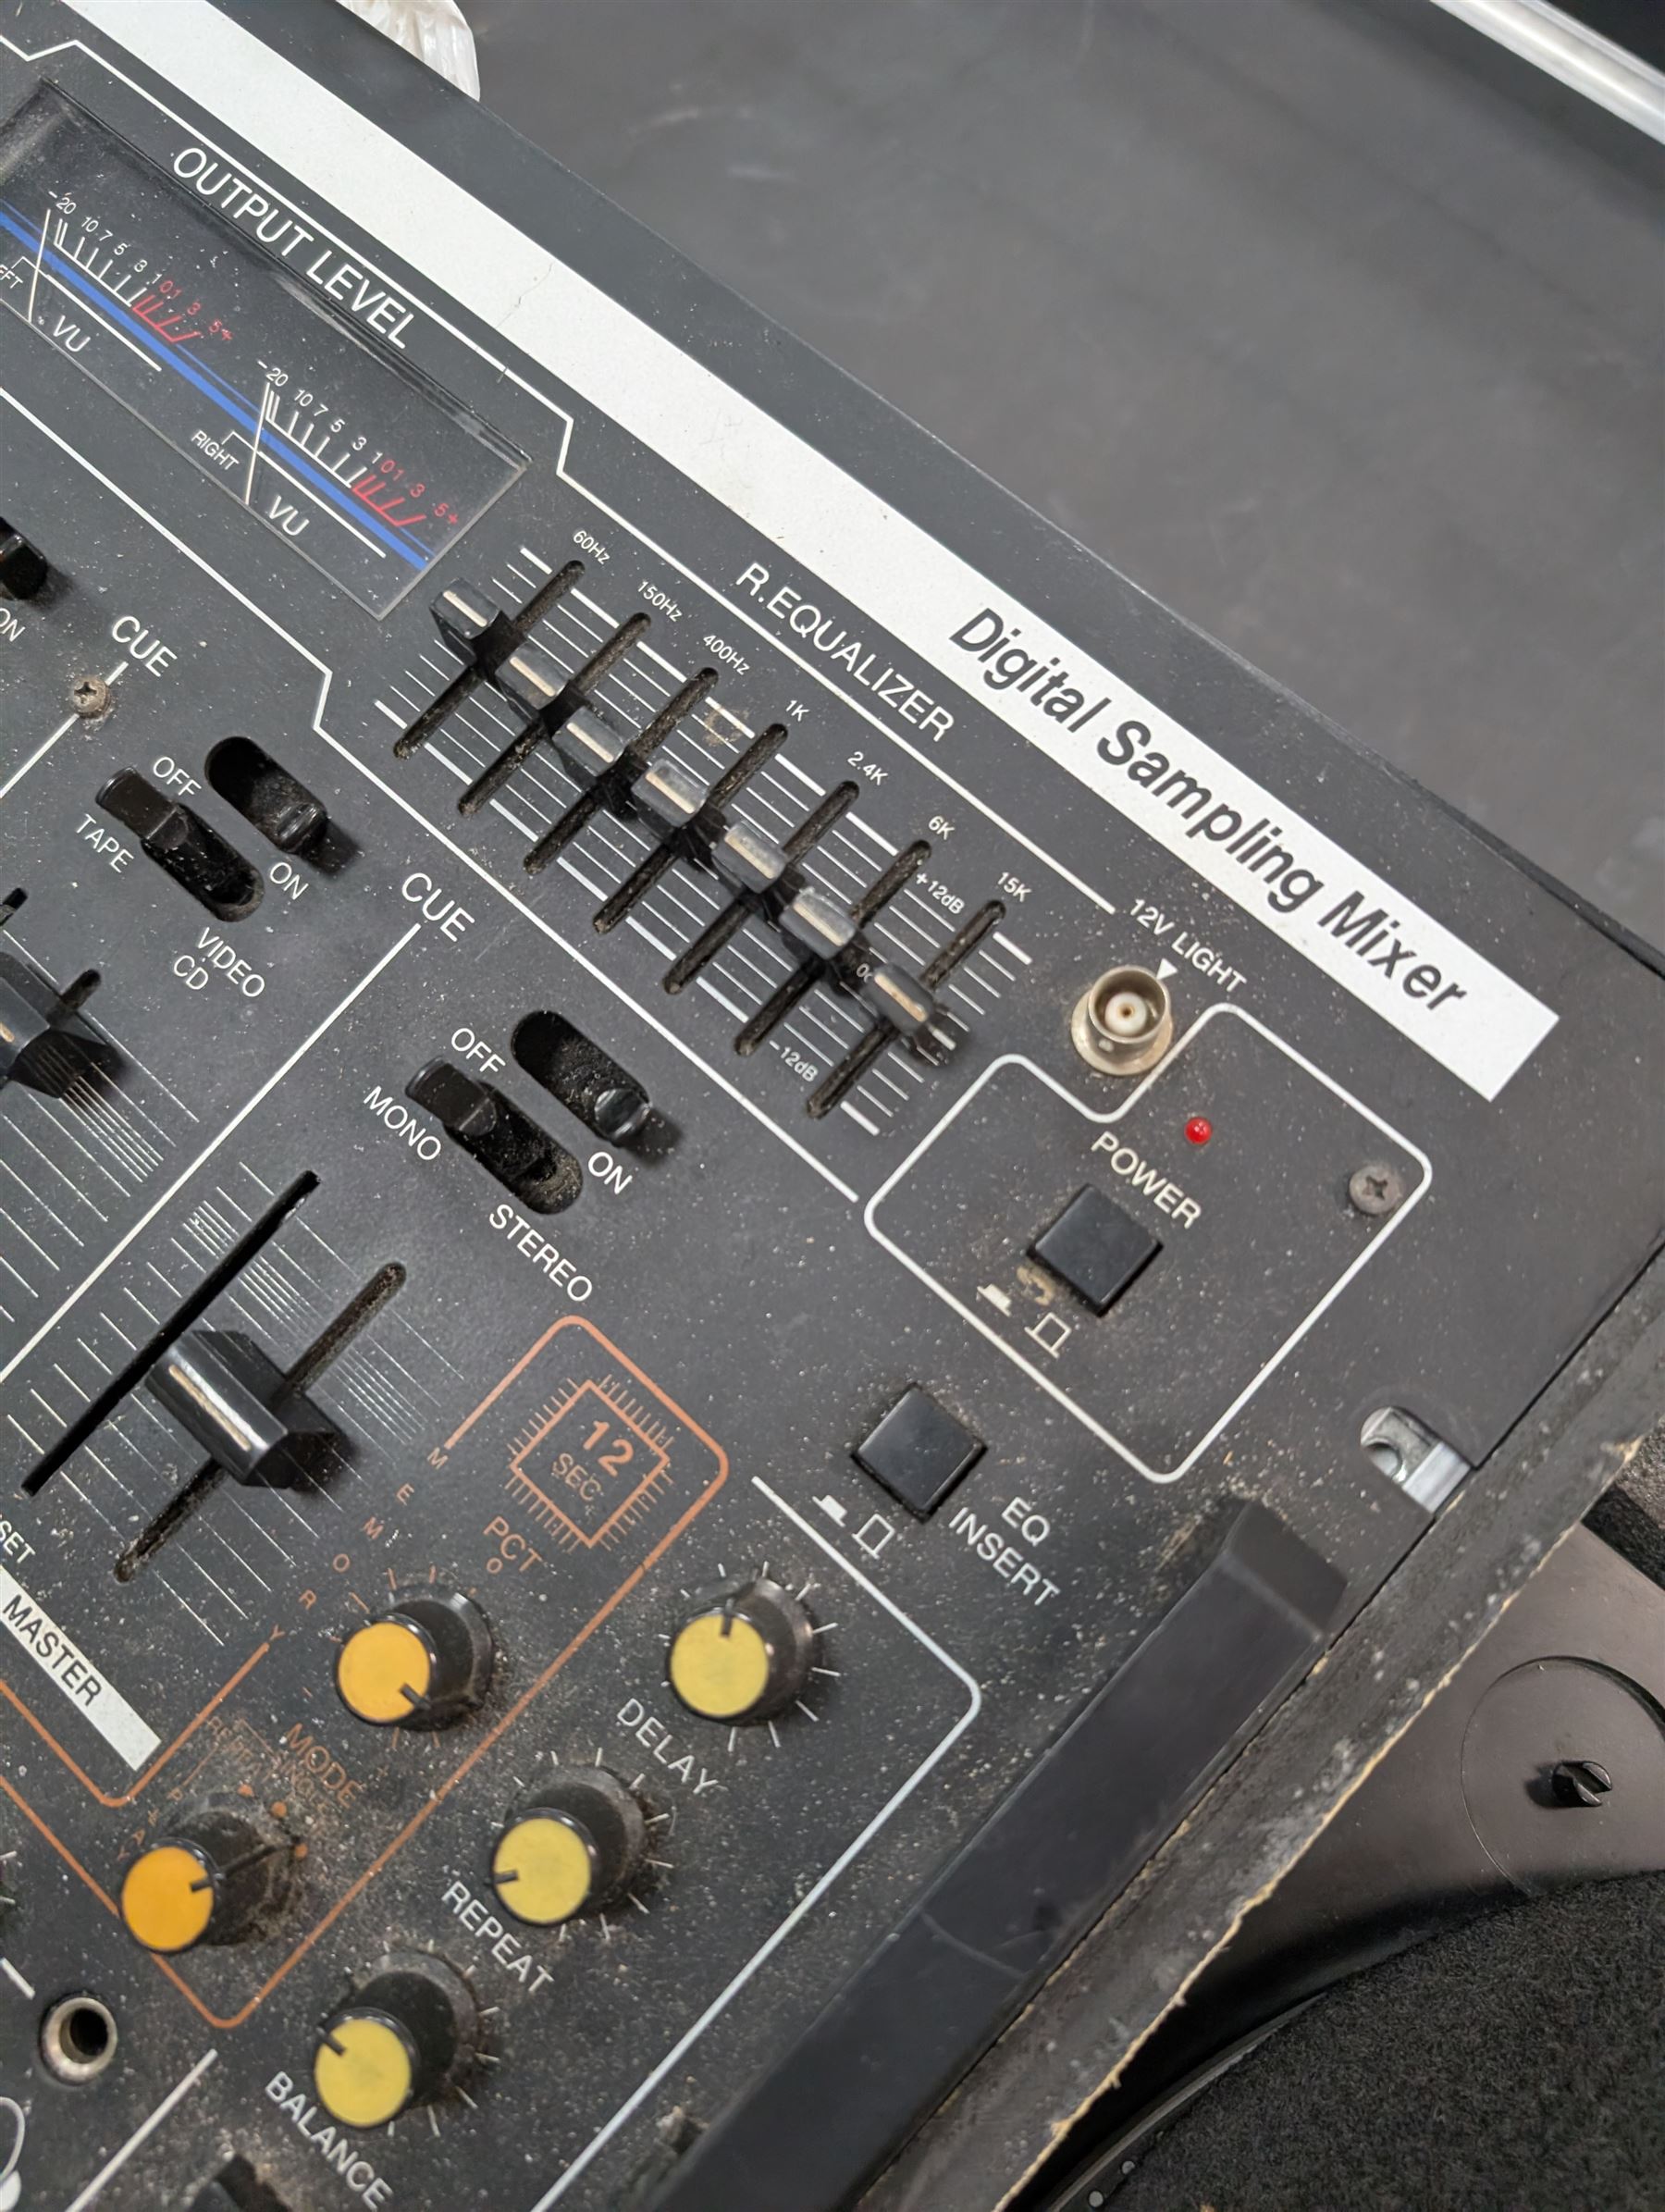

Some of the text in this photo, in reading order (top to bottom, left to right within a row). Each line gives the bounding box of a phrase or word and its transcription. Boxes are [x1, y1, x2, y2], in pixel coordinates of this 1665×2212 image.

[81, 215, 99, 232] 10
[101, 229, 114, 242] 7
[114, 242, 128, 256] 5
[173, 147, 419, 349] OUTPUT LEVEL
[52, 315, 91, 352] VU
[191, 429, 240, 471] RIGHT
[293, 389, 314, 407] 10
[313, 403, 328, 417] 7
[330, 419, 346, 433] 5
[352, 436, 367, 451] 3
[410, 484, 426, 499] 3
[268, 495, 310, 536] VU
[572, 528, 611, 566] 60Hz
[636, 579, 683, 624] 150Hz
[111, 615, 178, 677] CUE
[702, 633, 751, 676] 400Hz
[735, 562, 956, 743] R.EQUALIZER
[786, 699, 811, 723] 1K
[153, 756, 202, 798] OFF
[847, 750, 889, 786] 2.4K
[928, 816, 956, 840] 6K
[949, 607, 1468, 1012] Digital Sampling Mixer
[75, 813, 135, 874] TAPE
[269, 861, 310, 902] ON
[401, 872, 475, 942] CUE
[915, 873, 967, 915] +12dB
[996, 871, 1032, 903] 15K
[172, 954, 210, 992] CD
[195, 927, 265, 998] VIDEO
[1128, 897, 1248, 995] 12V LIGHT
[450, 1028, 507, 1075] OFF
[769, 1040, 819, 1082] -12dB
[363, 1085, 442, 1162] MONO
[587, 1151, 634, 1196] ON
[1091, 1131, 1202, 1230] POWER
[488, 1204, 594, 1303] STEREO
[582, 1419, 635, 1477] 12
[552, 1452, 602, 1502] SEC
[483, 1515, 545, 1573] PCT
[1000, 1496, 1052, 1548] EQ
[948, 1506, 1061, 1607] INSERT
[2, 1594, 104, 1708] MASTER
[285, 1723, 363, 1809] MODE
[616, 1697, 719, 1796] DELAY
[440, 1880, 554, 1993] REPEAT
[265, 2070, 394, 2210] BALANCE
